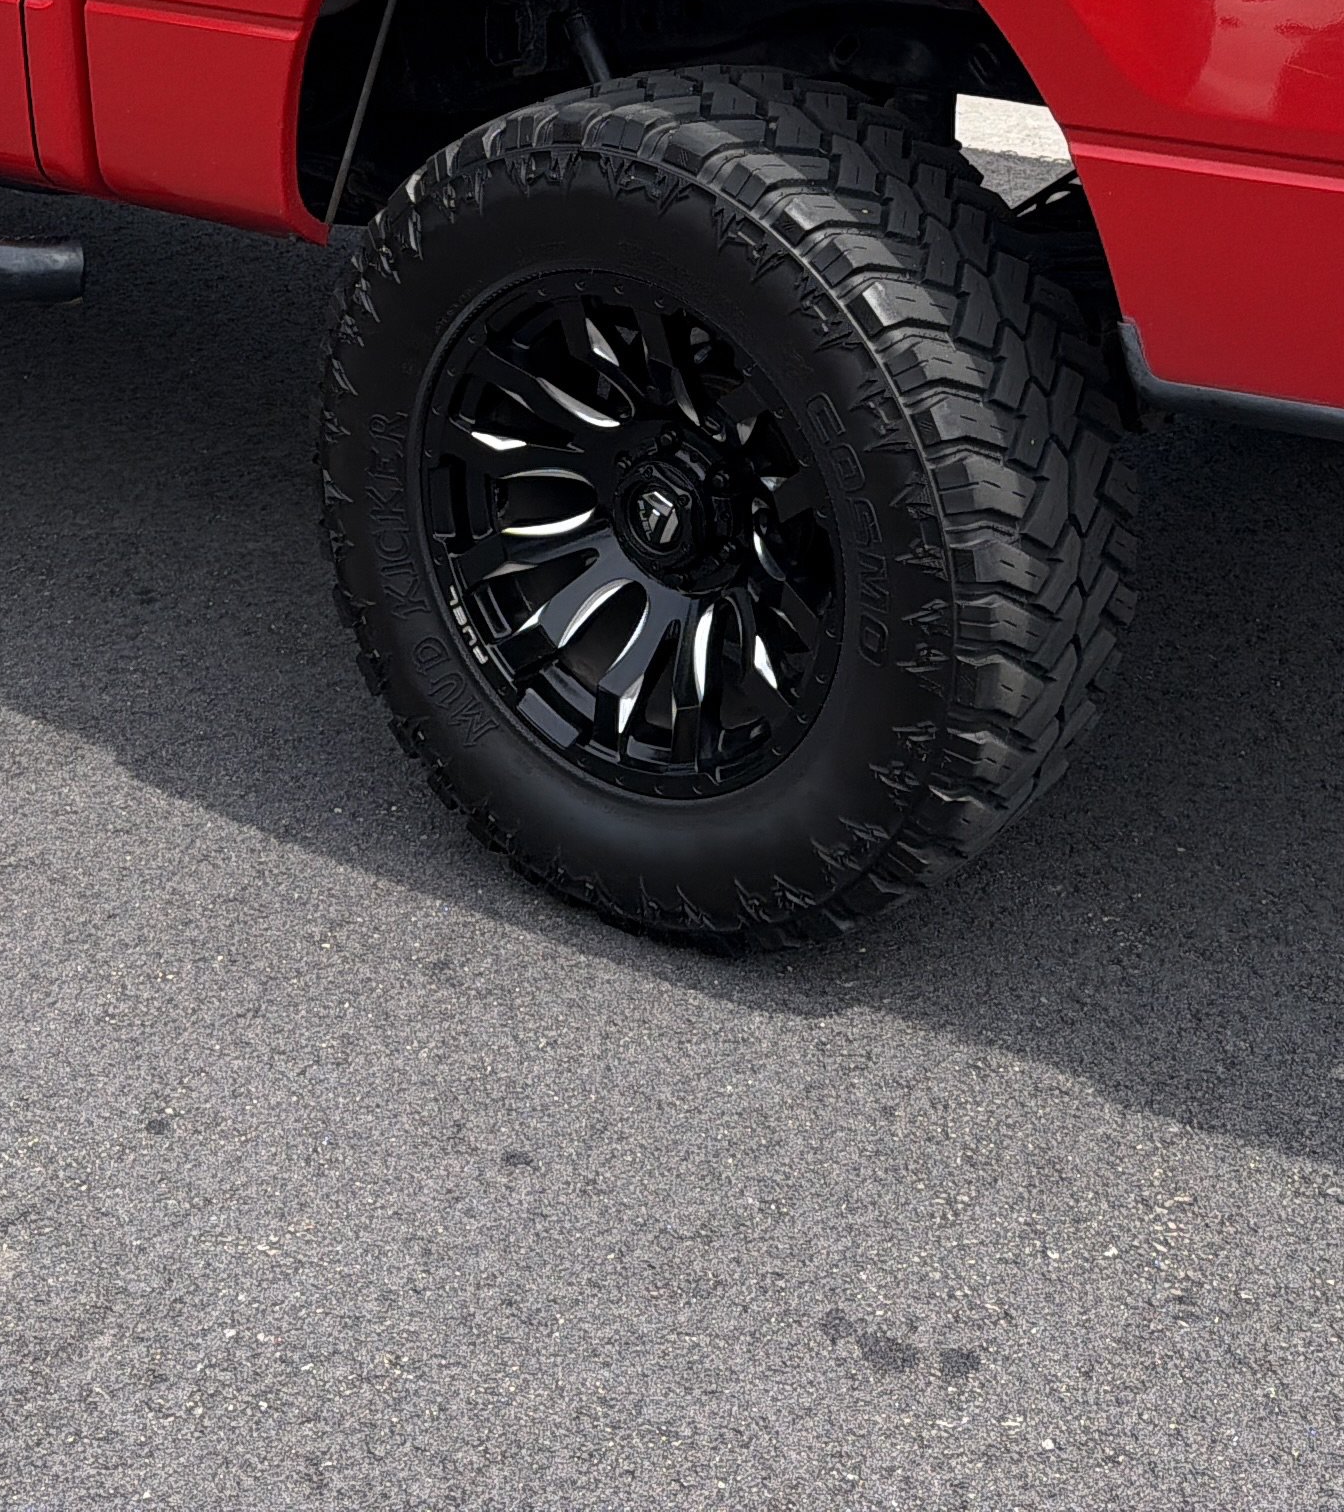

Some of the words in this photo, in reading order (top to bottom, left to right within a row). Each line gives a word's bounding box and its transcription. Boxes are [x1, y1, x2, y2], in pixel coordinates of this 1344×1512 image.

[364, 411, 434, 624] KICKER
[806, 391, 891, 668] COSMO
[410, 634, 501, 749] MUD
[449, 584, 489, 665] FUEL
